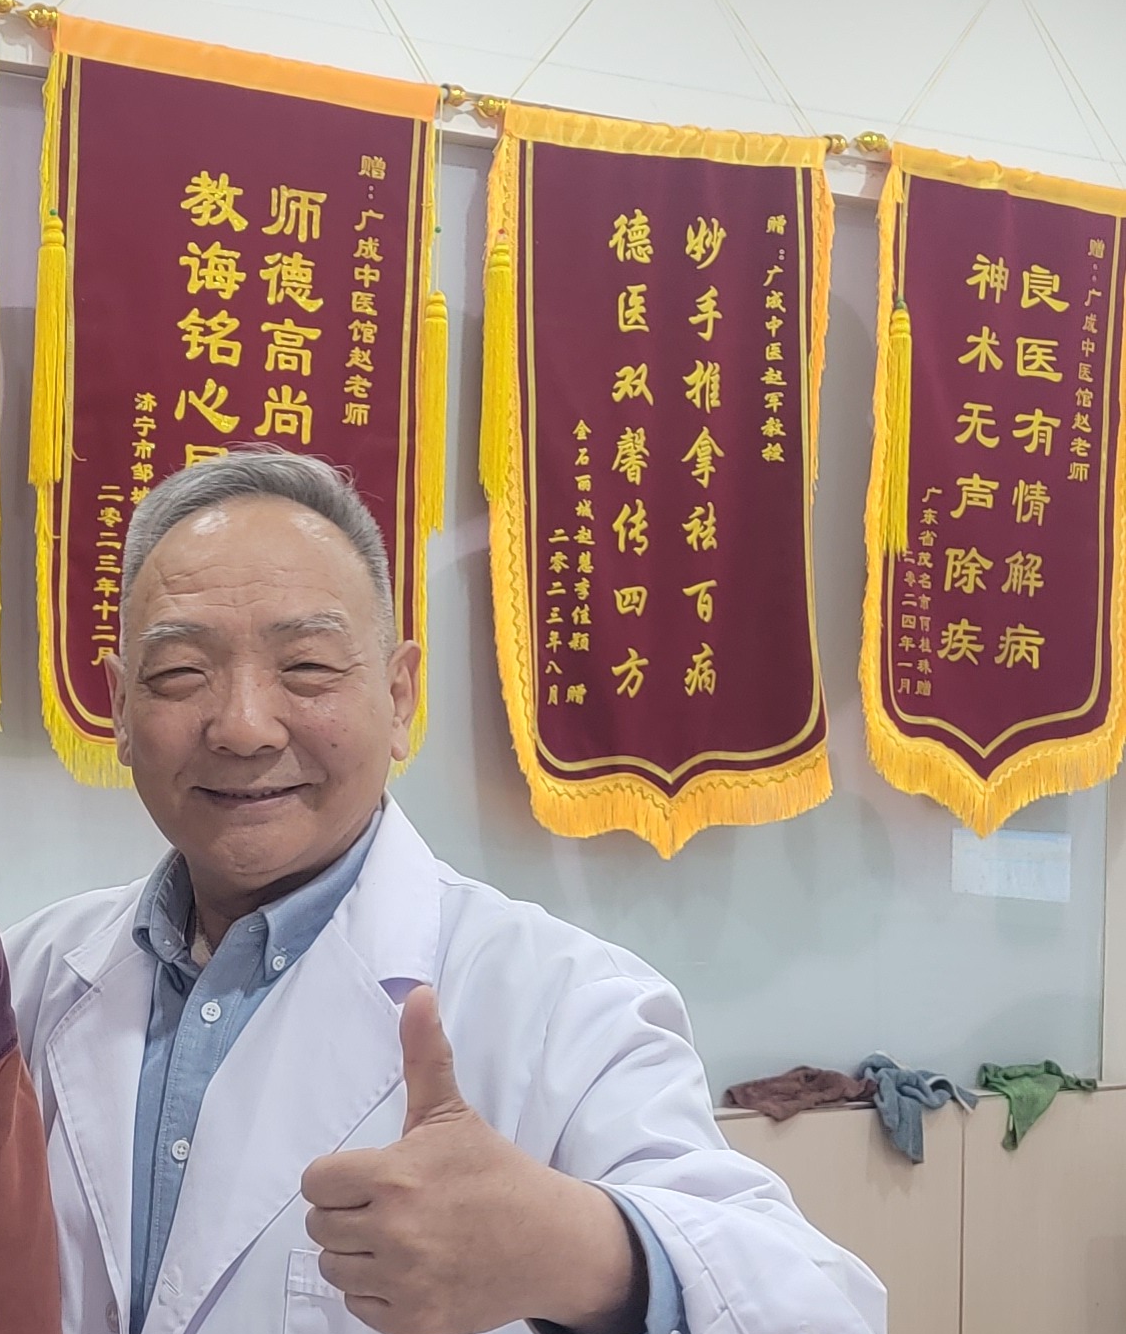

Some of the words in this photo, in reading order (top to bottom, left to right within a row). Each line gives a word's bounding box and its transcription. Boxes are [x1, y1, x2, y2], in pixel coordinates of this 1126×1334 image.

[254, 185, 327, 444] 师德高尚
[609, 209, 653, 697] 德医双馨传四方
[682, 217, 727, 696] 妙手推拿祛百病
[937, 254, 1009, 663] 神术无声除疾
[995, 265, 1069, 669] 良医有情解病
[546, 529, 569, 705] 二零二三年八月
